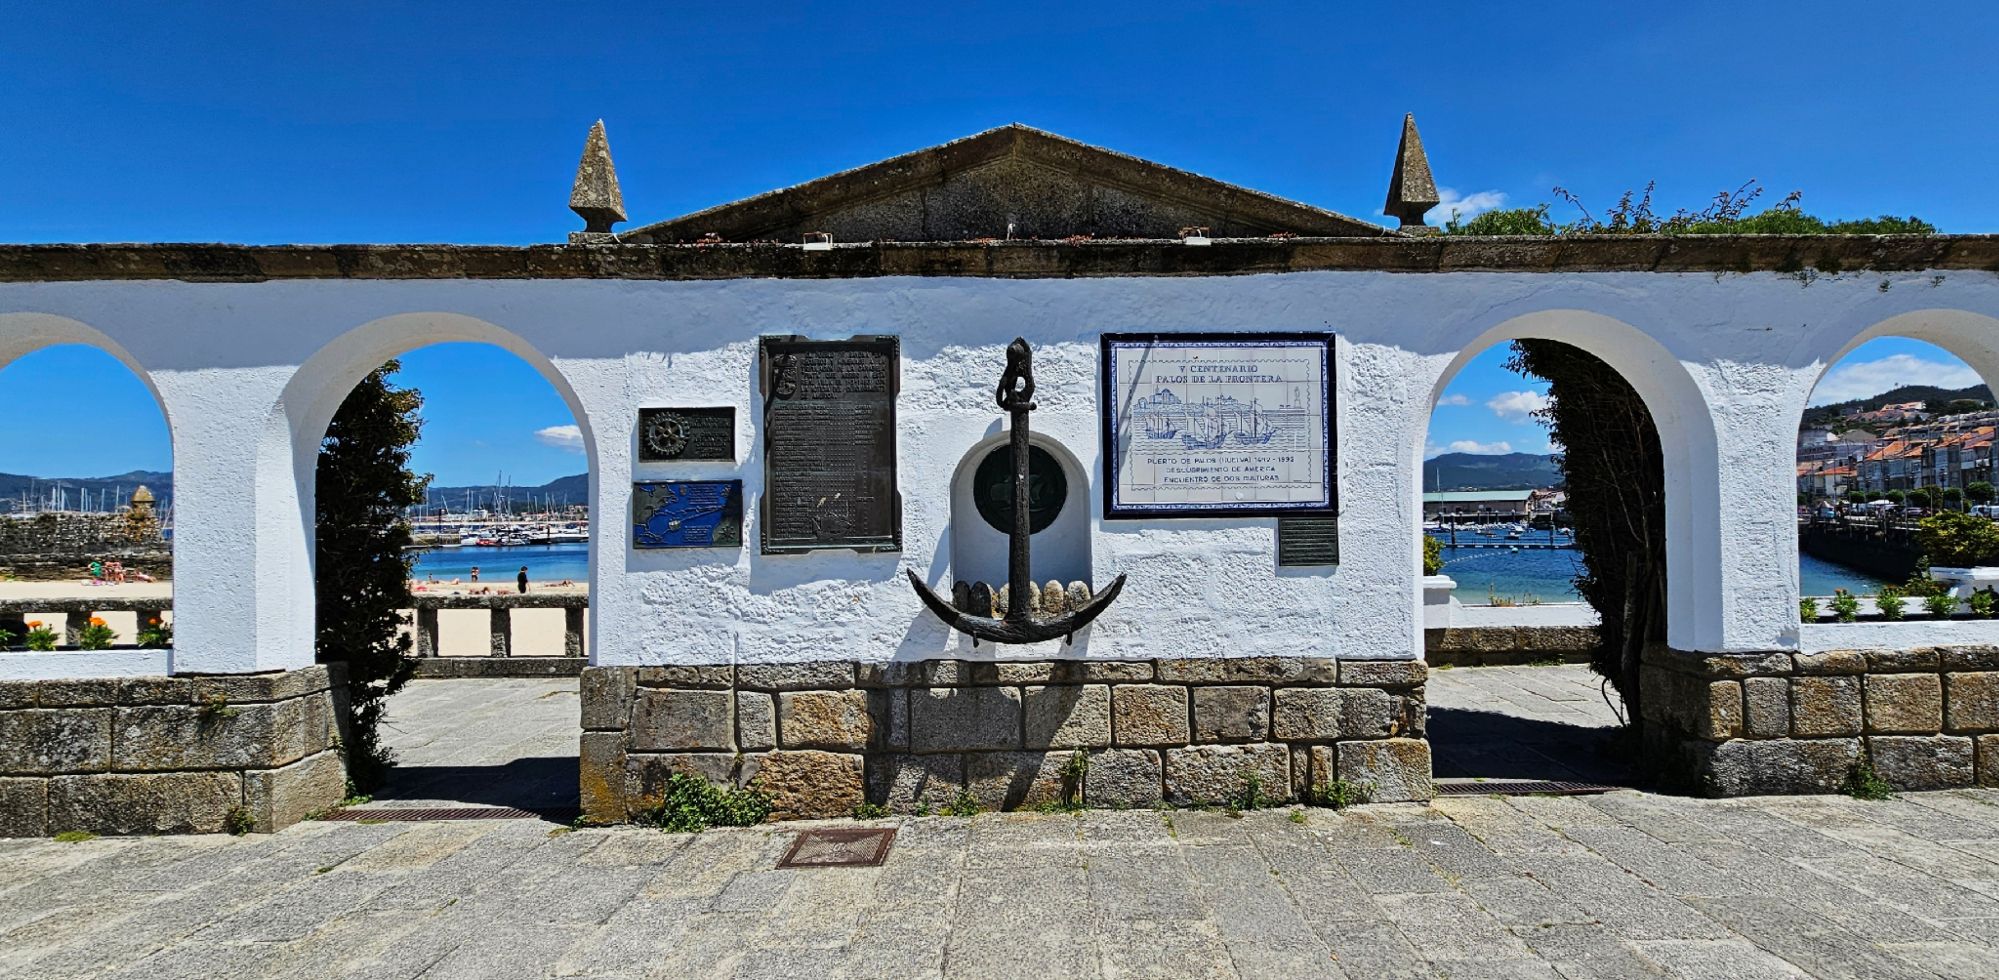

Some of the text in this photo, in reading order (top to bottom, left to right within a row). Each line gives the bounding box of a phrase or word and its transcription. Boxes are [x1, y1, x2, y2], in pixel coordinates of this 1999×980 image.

[1178, 364, 1258, 373] V CENTENARIO
[1155, 374, 1283, 384] PALOS DE LA FRONTERA
